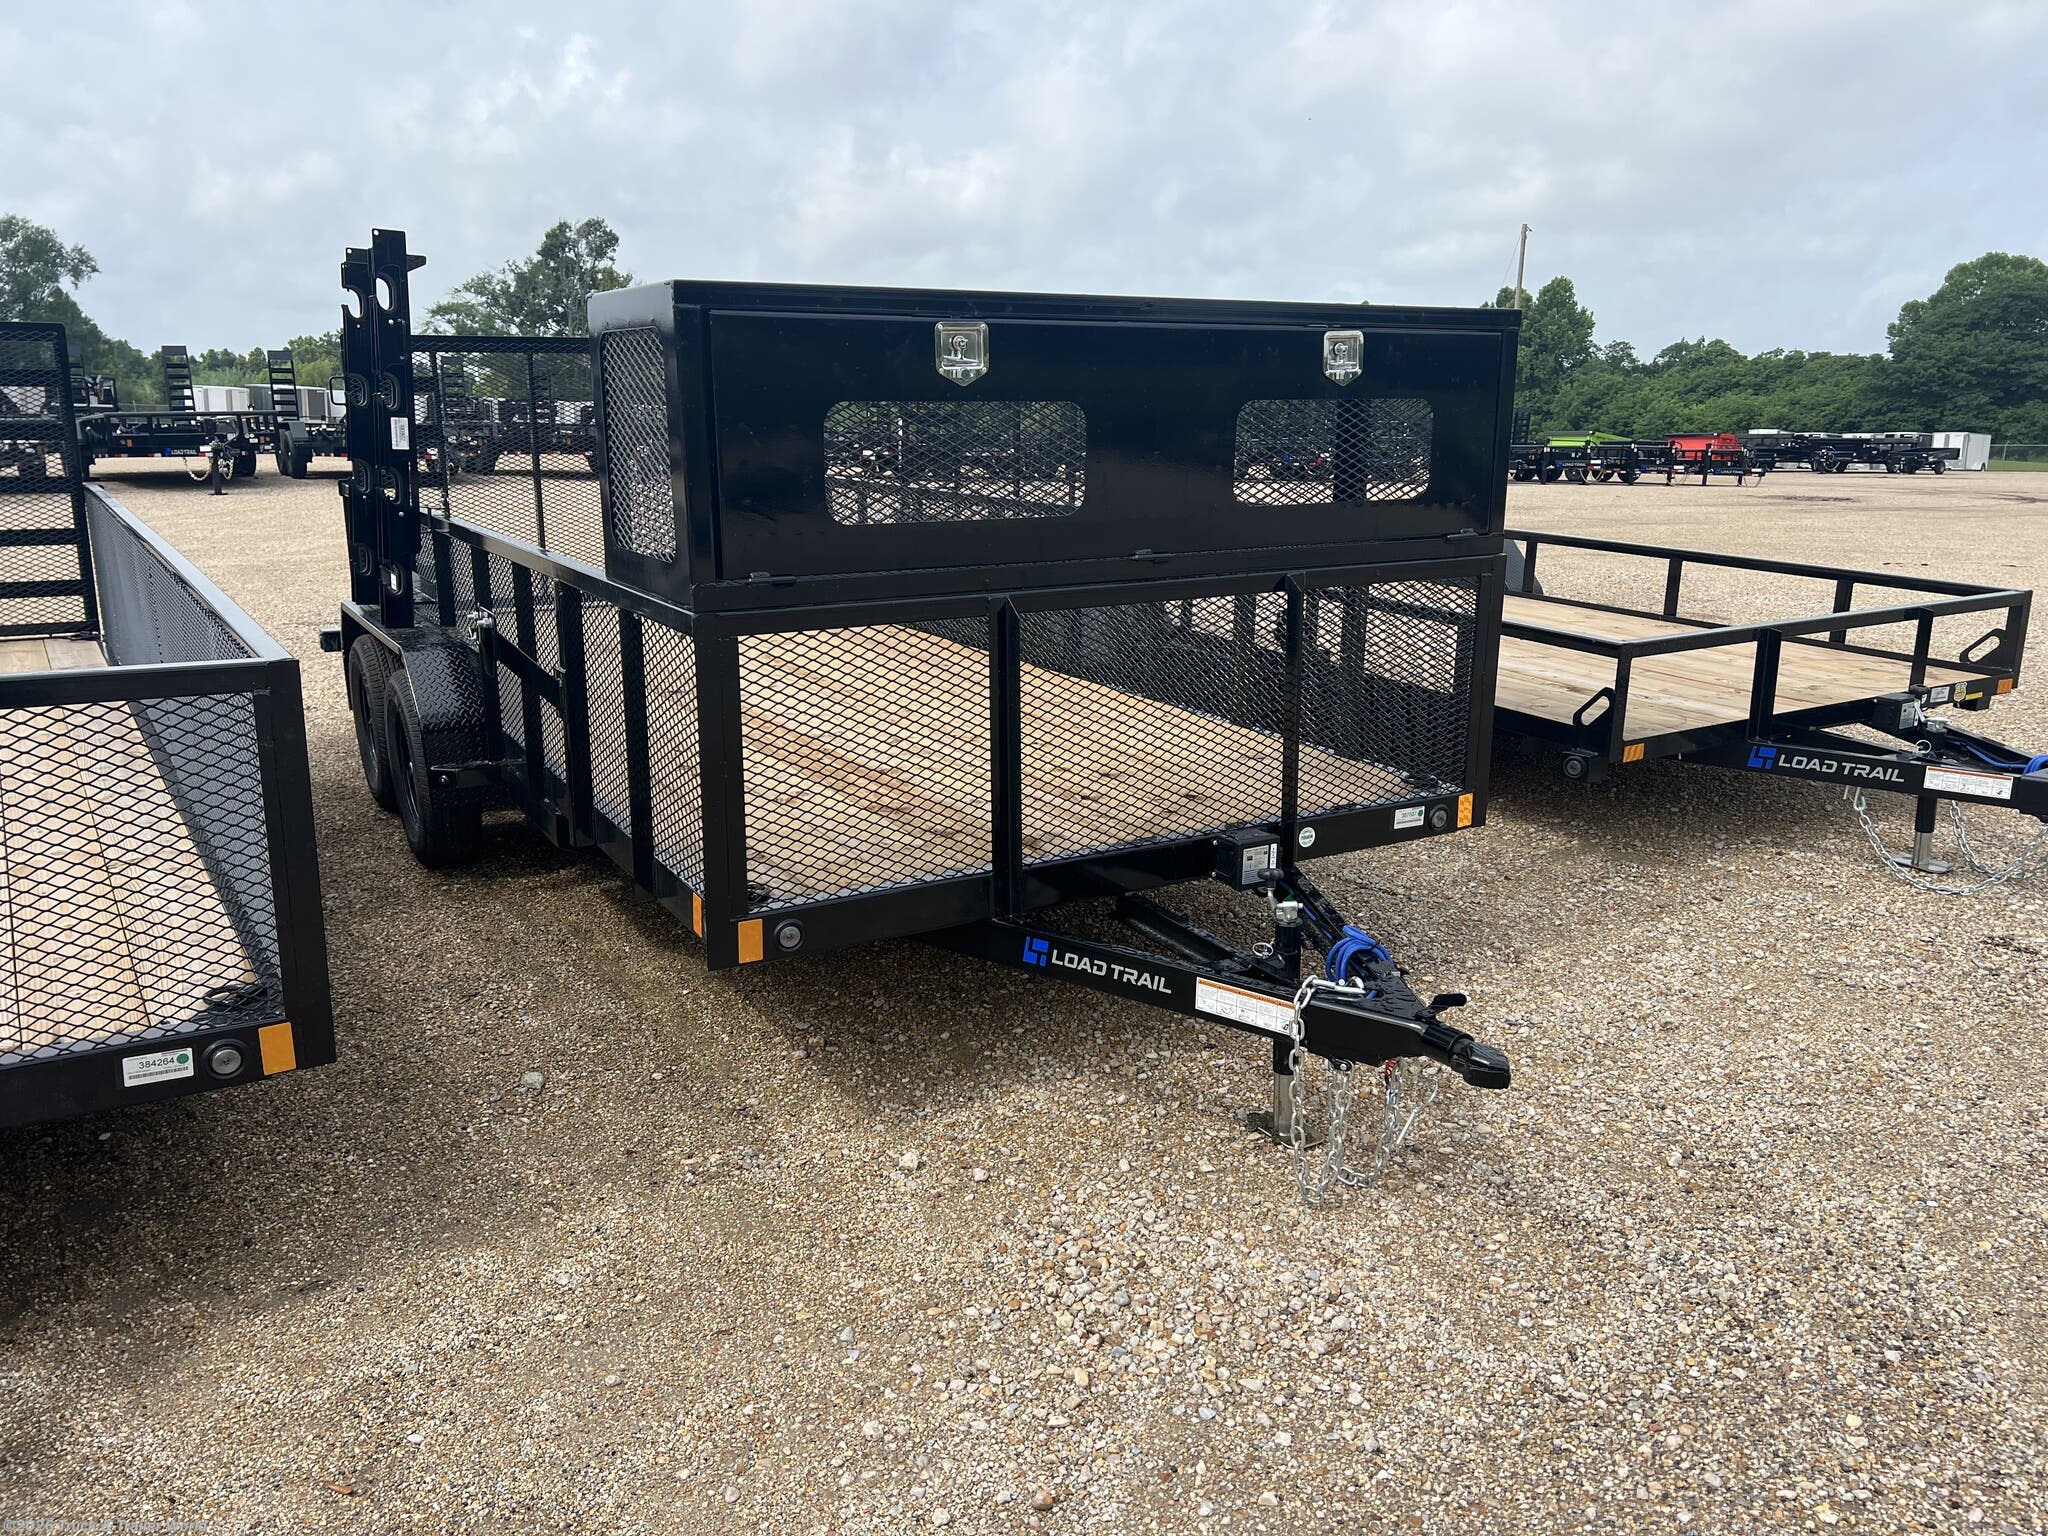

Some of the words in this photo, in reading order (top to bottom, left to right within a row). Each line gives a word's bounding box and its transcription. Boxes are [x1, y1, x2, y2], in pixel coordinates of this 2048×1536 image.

[1778, 754, 1838, 773] LOAD
[1841, 762, 1904, 782] TRAIL
[1051, 949, 1107, 976] LOAD
[1110, 964, 1173, 994] TRAIL
[138, 1057, 175, 1070] 384264
